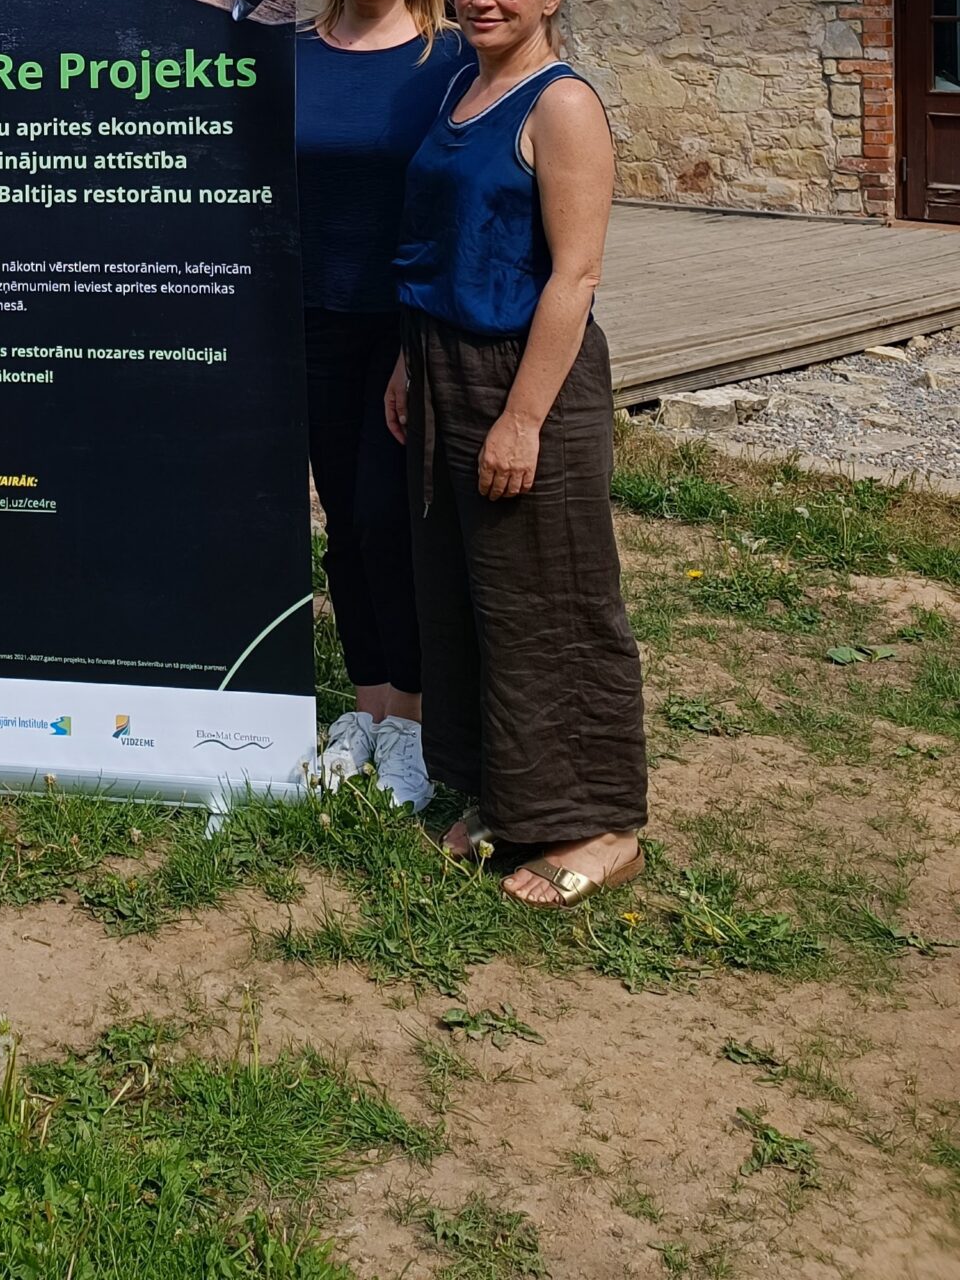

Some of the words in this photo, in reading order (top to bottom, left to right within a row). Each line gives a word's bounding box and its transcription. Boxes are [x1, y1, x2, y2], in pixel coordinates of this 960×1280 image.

[60, 48, 257, 100] Projekts
[16, 118, 92, 141] aprites
[98, 116, 233, 136] ekonomikas
[94, 151, 187, 169] attīstība
[83, 187, 192, 204] restorānu
[199, 186, 272, 204] nozarē
[2, 260, 46, 272] nākotni
[49, 261, 101, 273] vērstiem
[104, 261, 182, 275] restorāniem,
[185, 261, 252, 277] kafejnīcām
[74, 280, 113, 293] ieviest
[115, 281, 157, 296] aprites
[160, 281, 235, 294] ekonomikas
[11, 345, 83, 358] restorānu
[87, 348, 145, 360] nozares
[149, 347, 227, 365] revolūcijai
[18, 717, 48, 730] Institute
[121, 737, 155, 748] VIDZEME
[233, 732, 271, 744] Centrum
